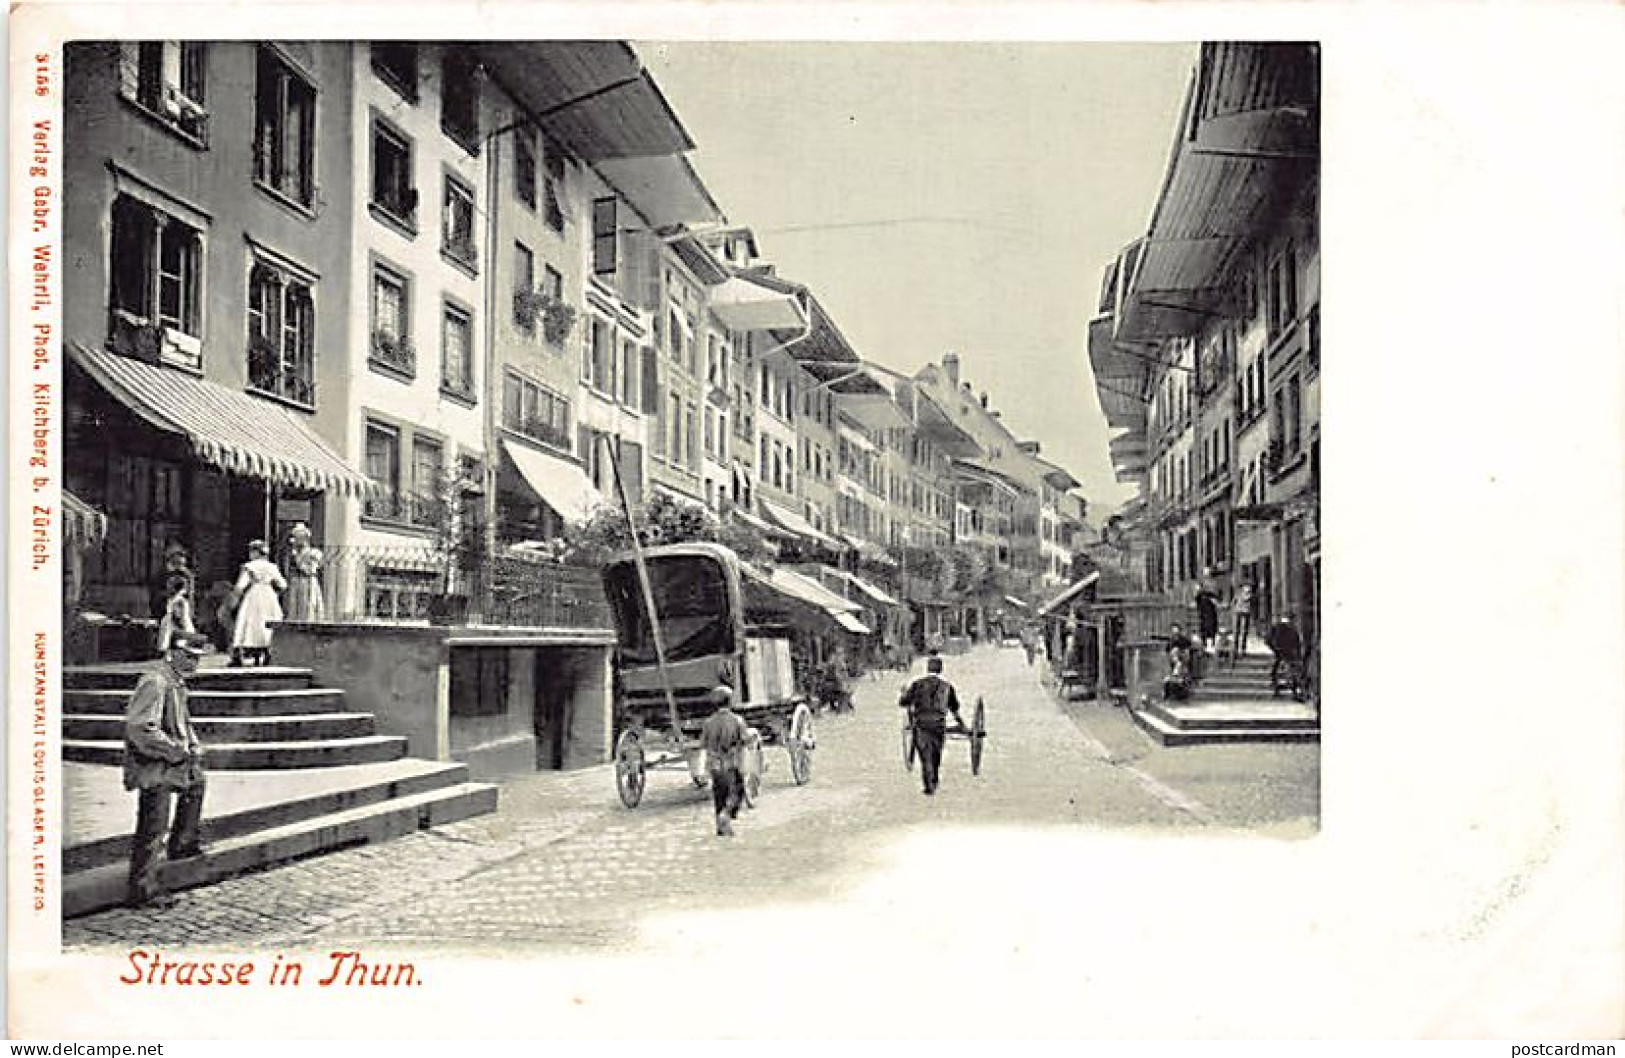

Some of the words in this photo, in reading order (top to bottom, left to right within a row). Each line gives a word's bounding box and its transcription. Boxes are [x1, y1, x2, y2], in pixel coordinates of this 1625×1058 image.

[32, 119, 51, 178] Verlag
[32, 185, 51, 233] Gebr.
[30, 244, 51, 312] Wehrli,
[32, 322, 51, 370] Phot.
[30, 382, 51, 468] Kilchberg
[32, 475, 49, 492] b.
[31, 503, 52, 571] Zürich.
[34, 631, 47, 736] KUNSTANSTALT
[33, 740, 46, 784] LOUIS
[119, 950, 256, 986] Strasse
[268, 954, 304, 987] in
[318, 951, 424, 987] Thun.
